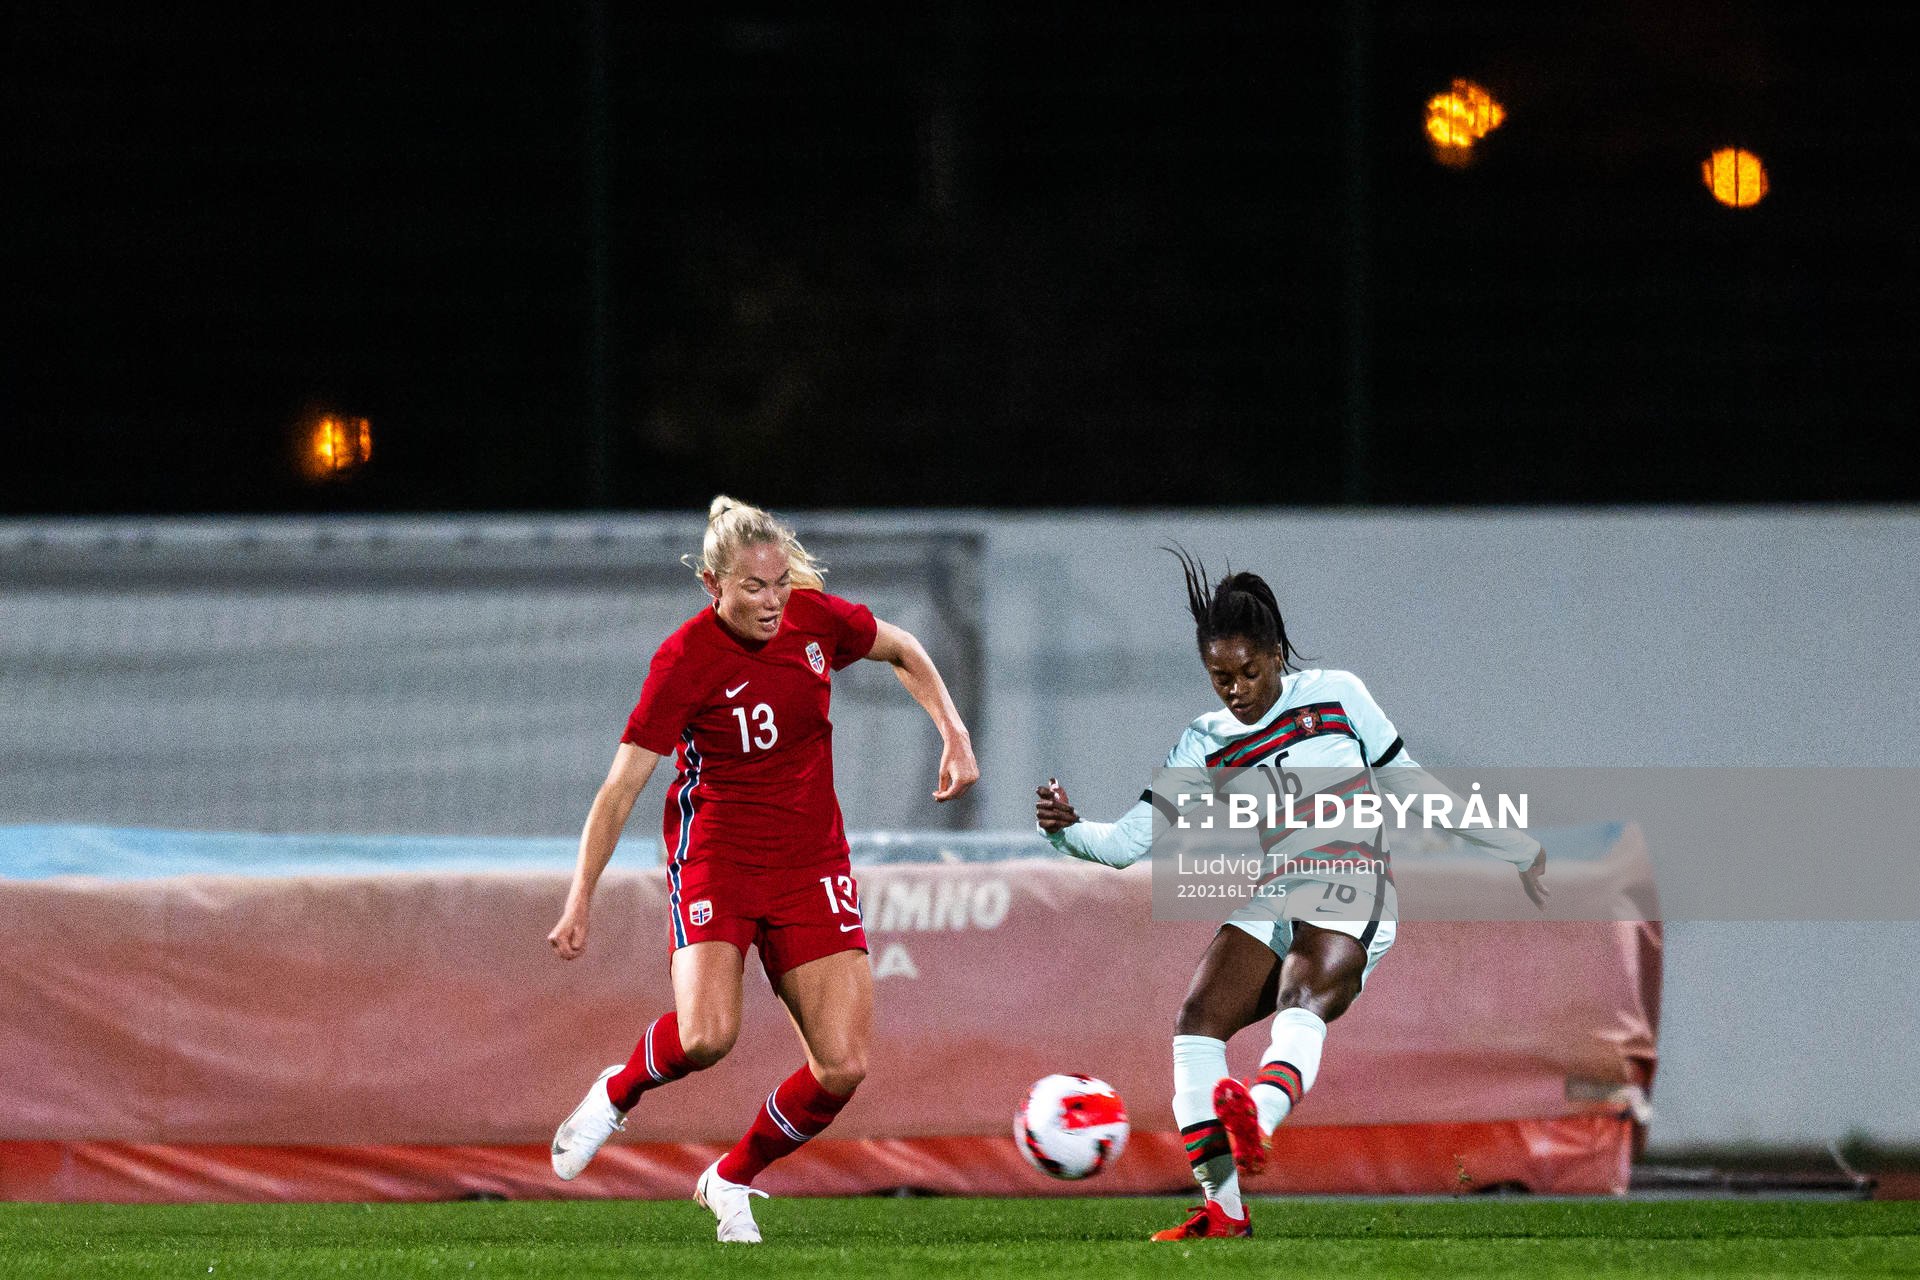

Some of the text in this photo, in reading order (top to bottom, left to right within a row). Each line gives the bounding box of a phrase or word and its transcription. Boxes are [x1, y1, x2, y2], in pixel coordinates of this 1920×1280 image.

[732, 703, 779, 753] 13
[1256, 750, 1303, 807] 16
[819, 875, 859, 914] 13
